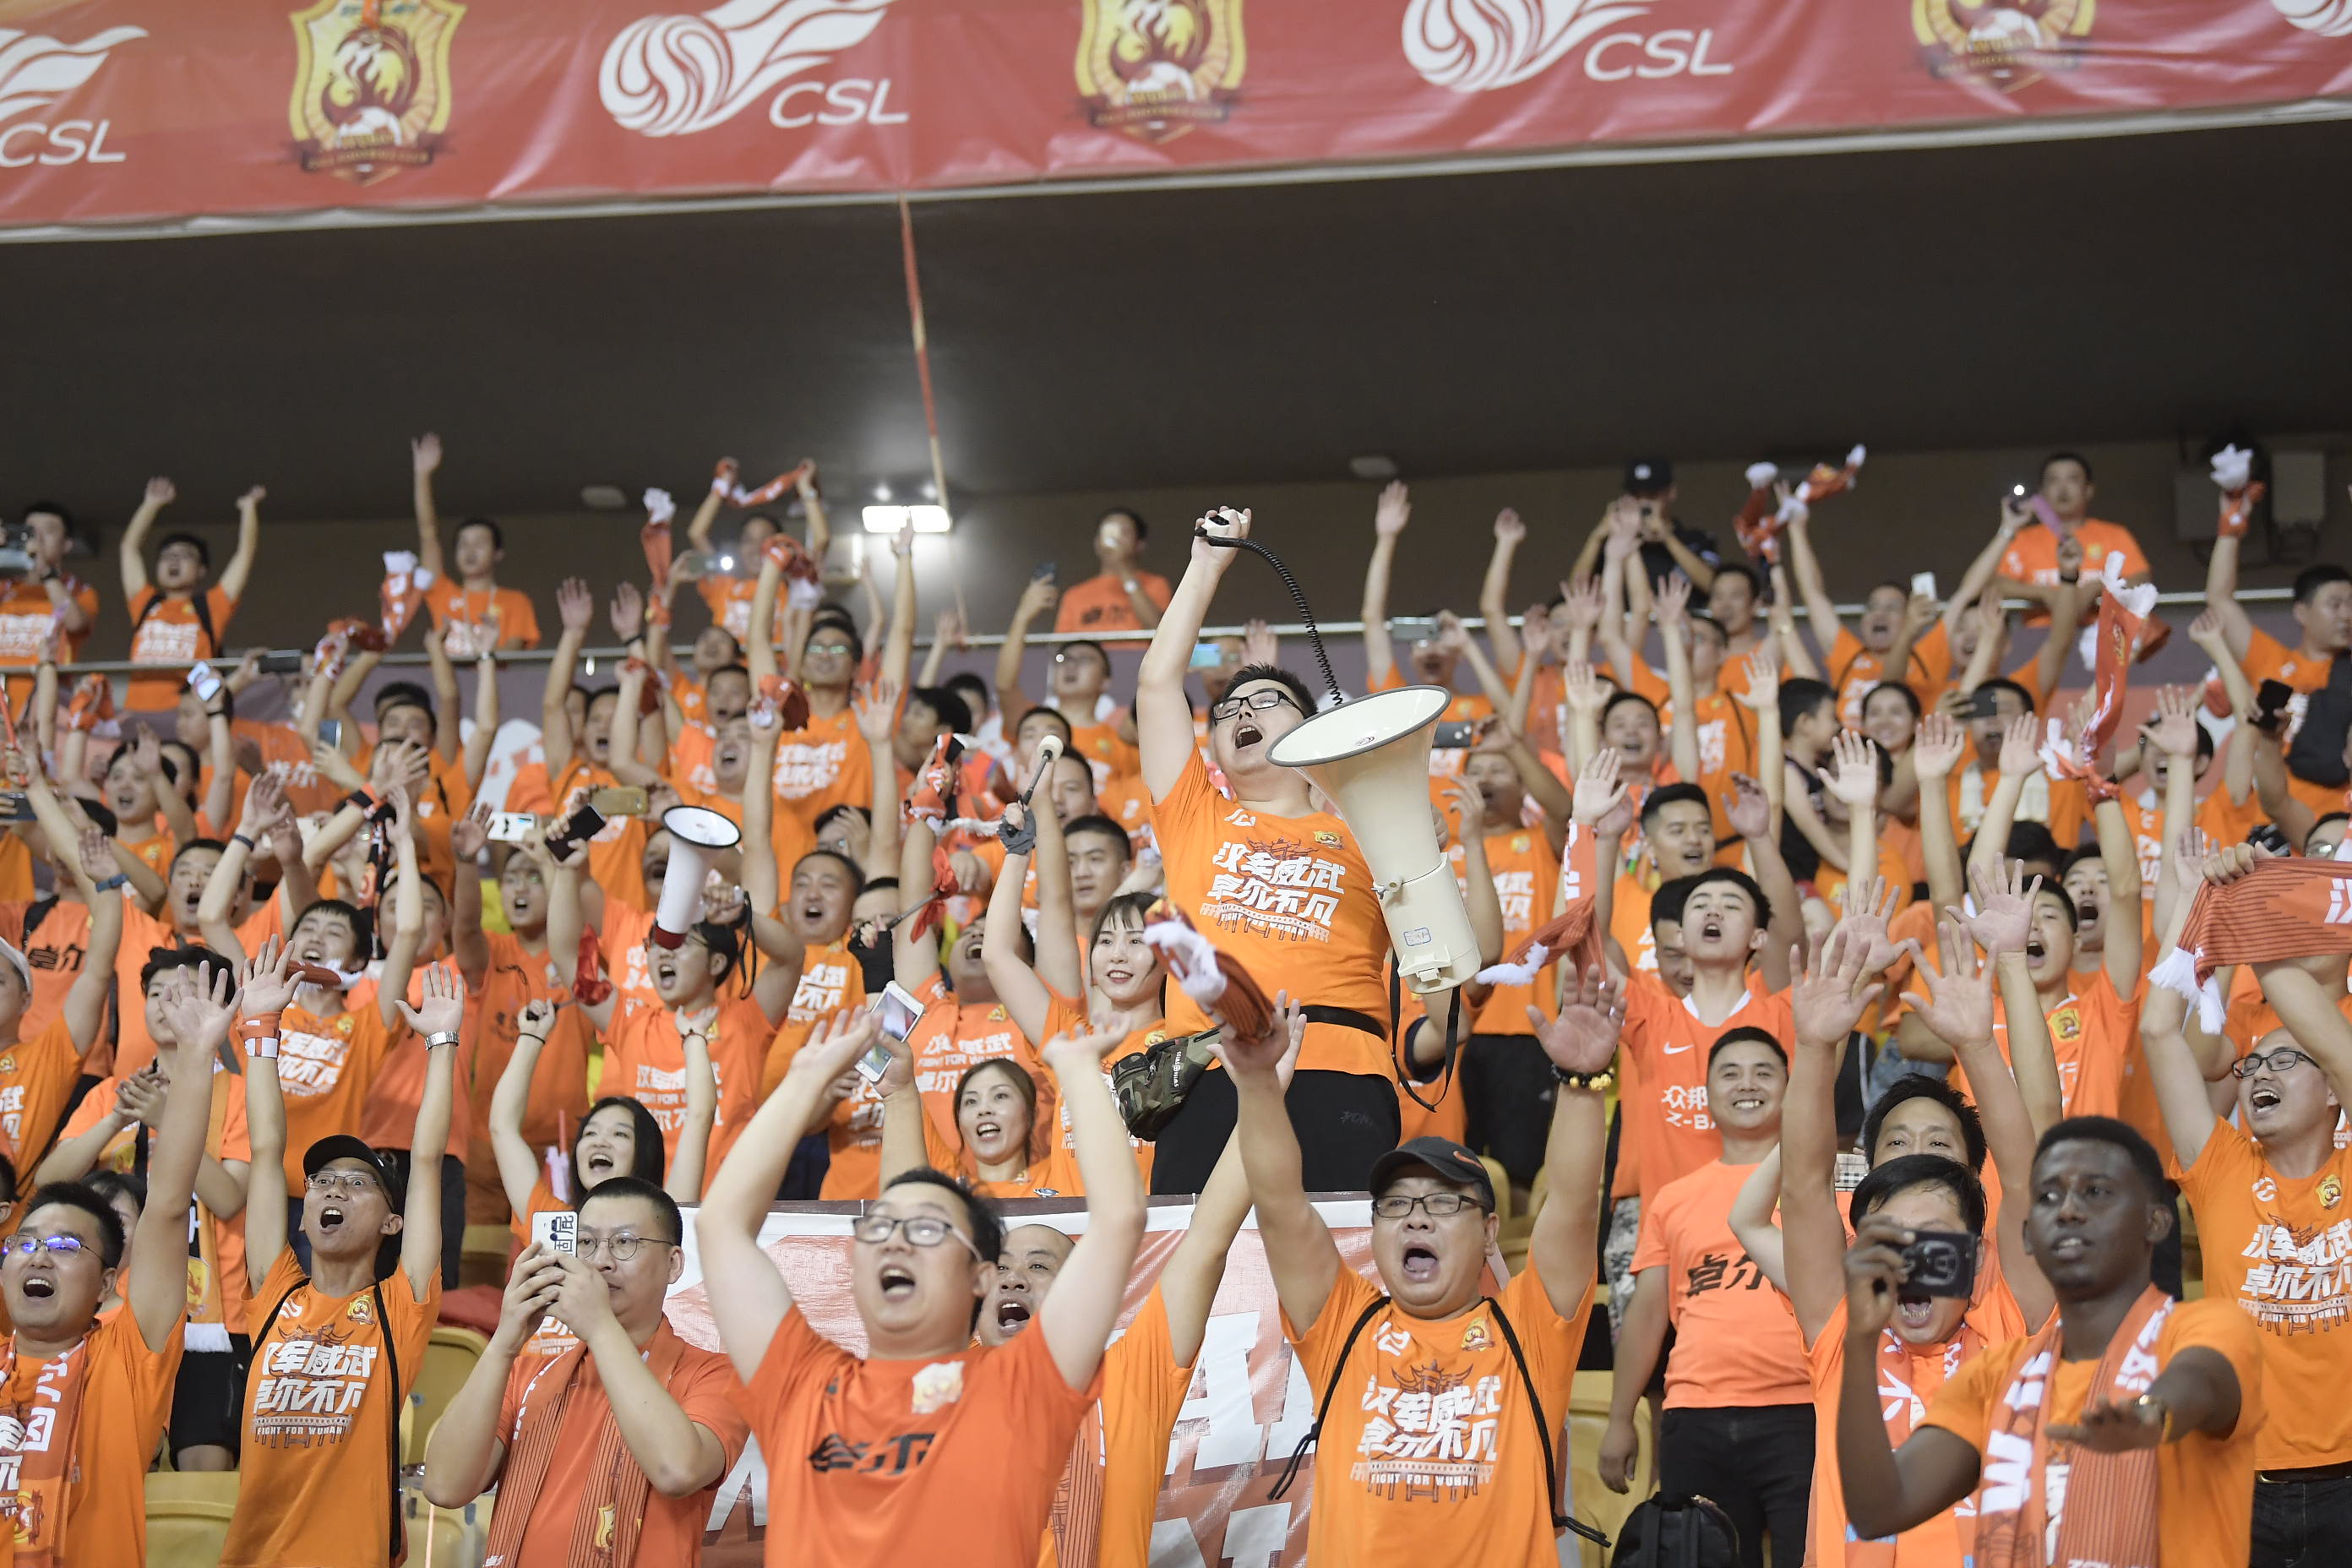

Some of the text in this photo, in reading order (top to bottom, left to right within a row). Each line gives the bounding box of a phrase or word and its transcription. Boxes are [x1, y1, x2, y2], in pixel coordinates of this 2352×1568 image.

[1584, 30, 1734, 81] CSL
[768, 79, 909, 128] CSL
[0, 120, 127, 167] CSL
[1212, 841, 1346, 895] 汉军威武
[1206, 874, 1340, 927] 卓尔不凡
[1221, 912, 1242, 923] FIGHT
[257, 1426, 343, 1435] FIGHT FOR WUHAN
[1371, 1473, 1399, 1484] FIGHT
[1407, 1473, 1430, 1485] FOR
